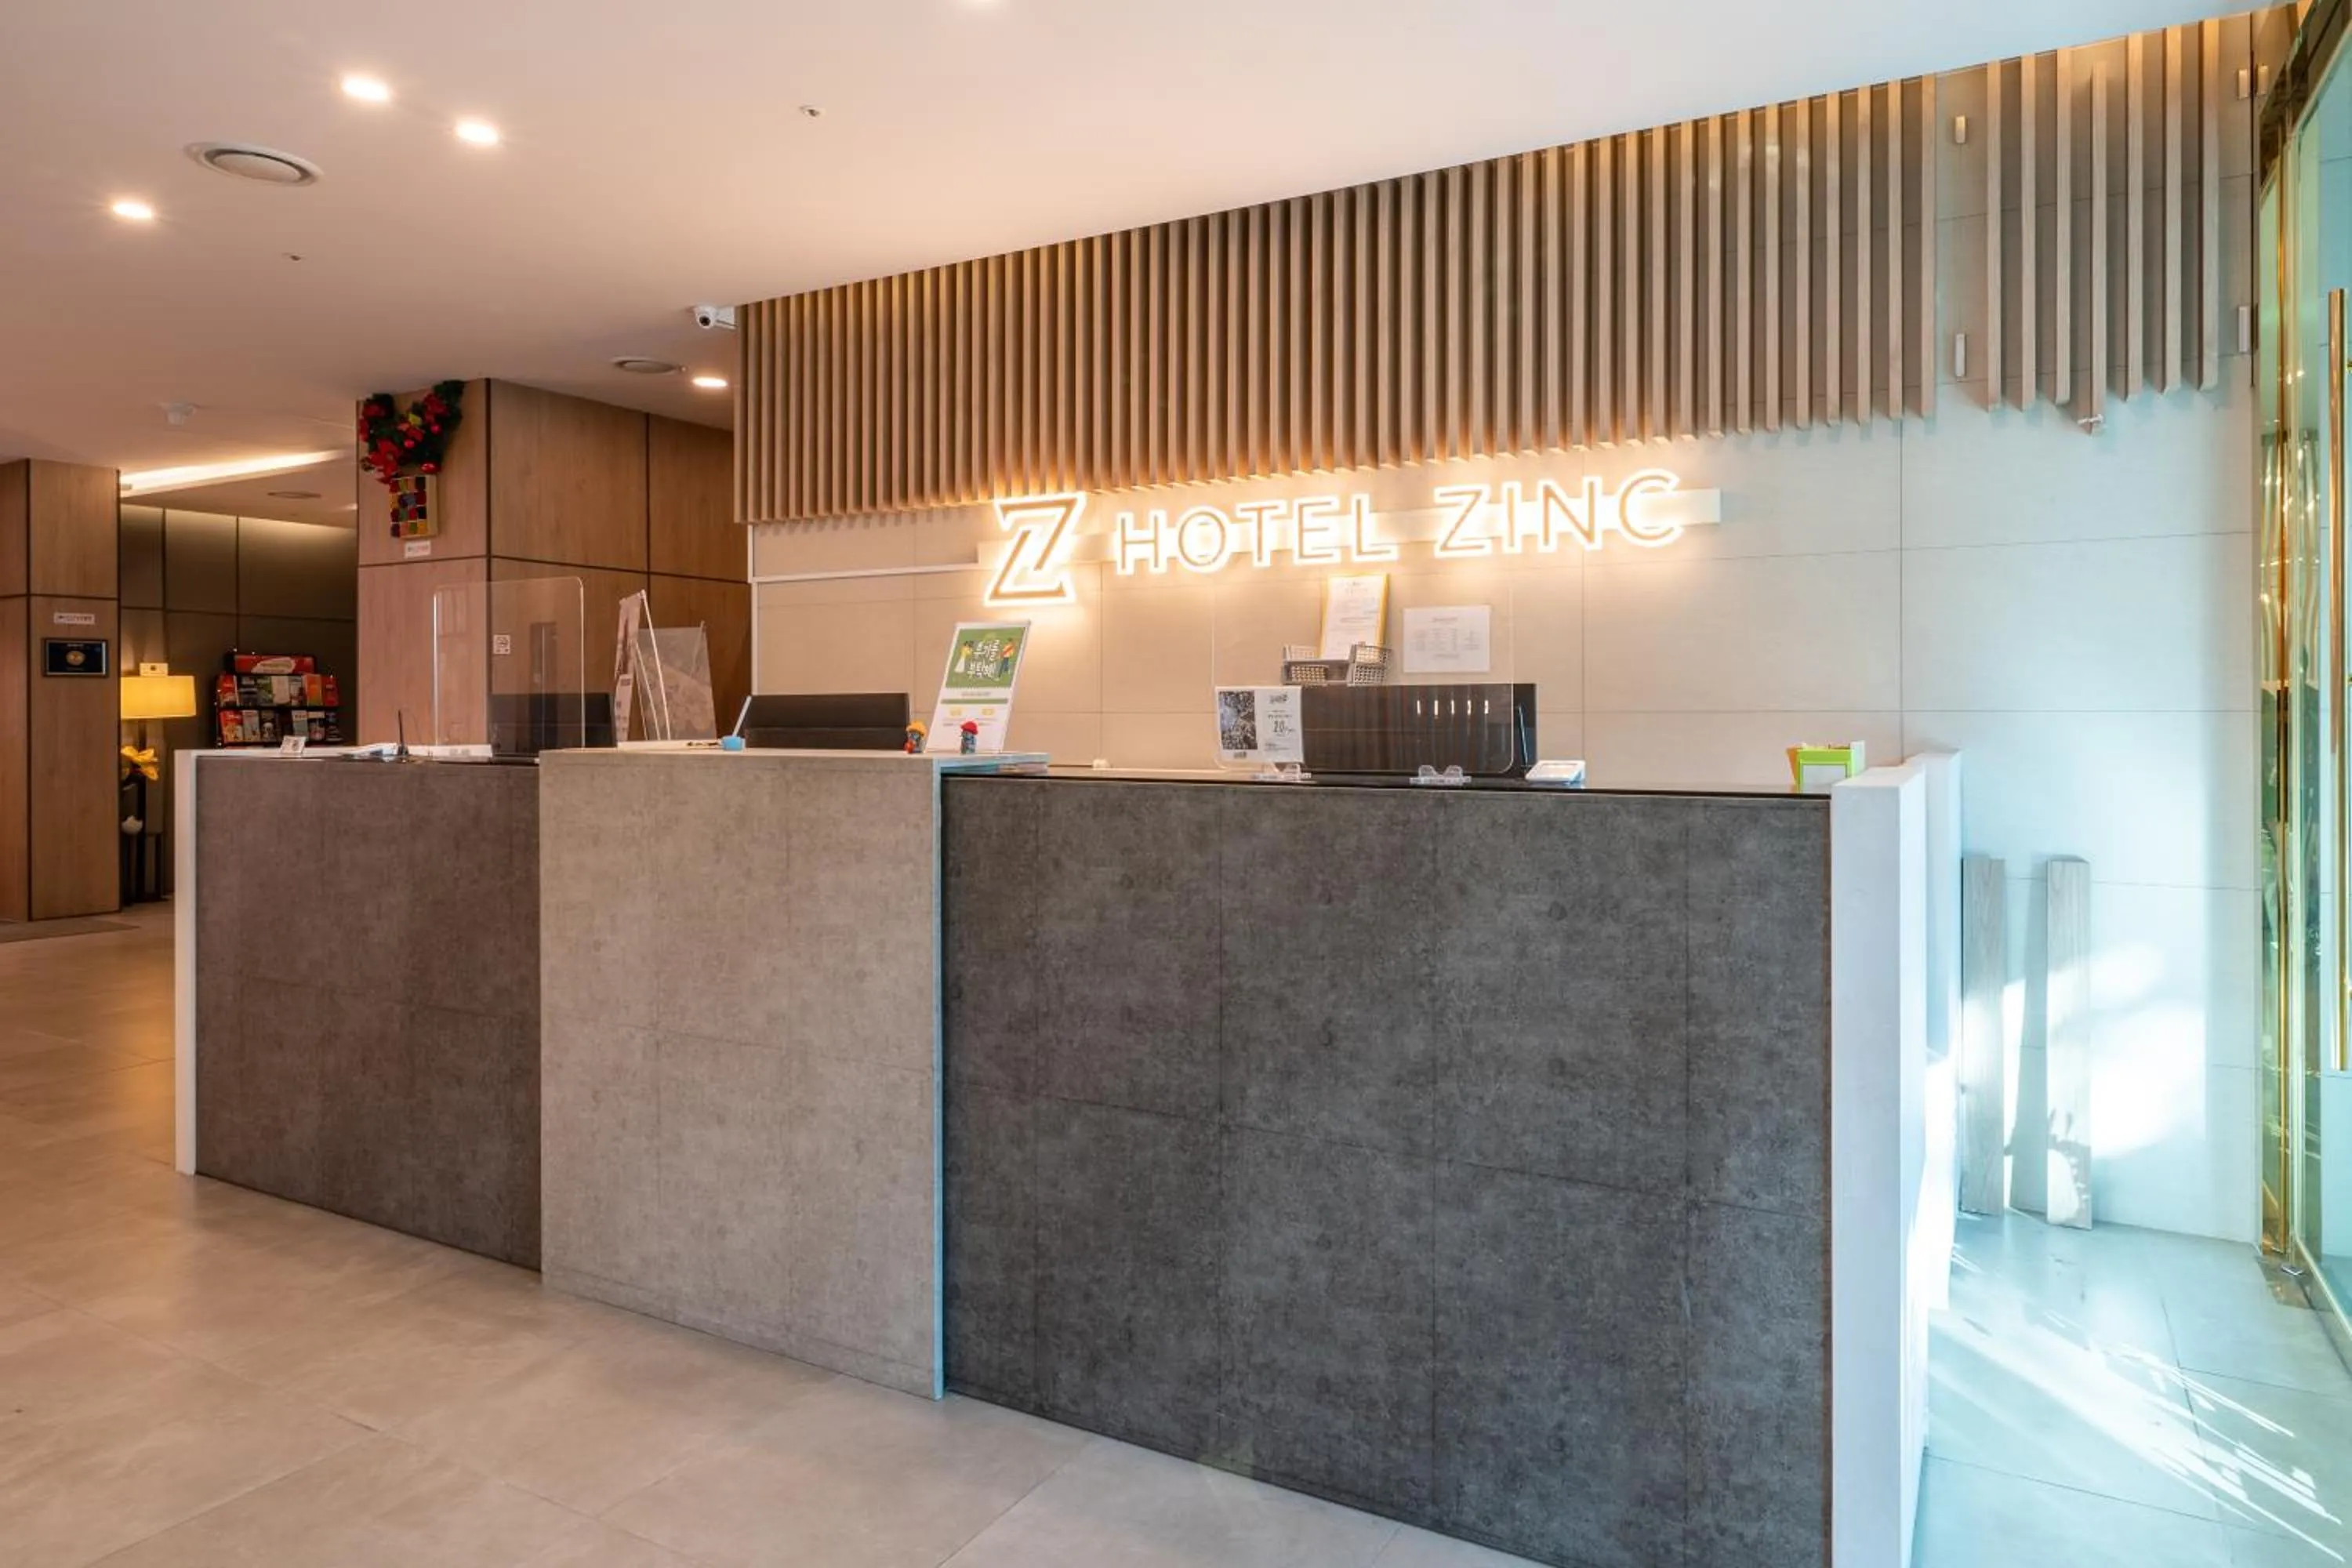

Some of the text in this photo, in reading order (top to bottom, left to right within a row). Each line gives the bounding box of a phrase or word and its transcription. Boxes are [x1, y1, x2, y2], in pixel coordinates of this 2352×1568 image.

[985, 493, 1085, 605] Z
[1117, 470, 1682, 574] HOTEL ZINC
